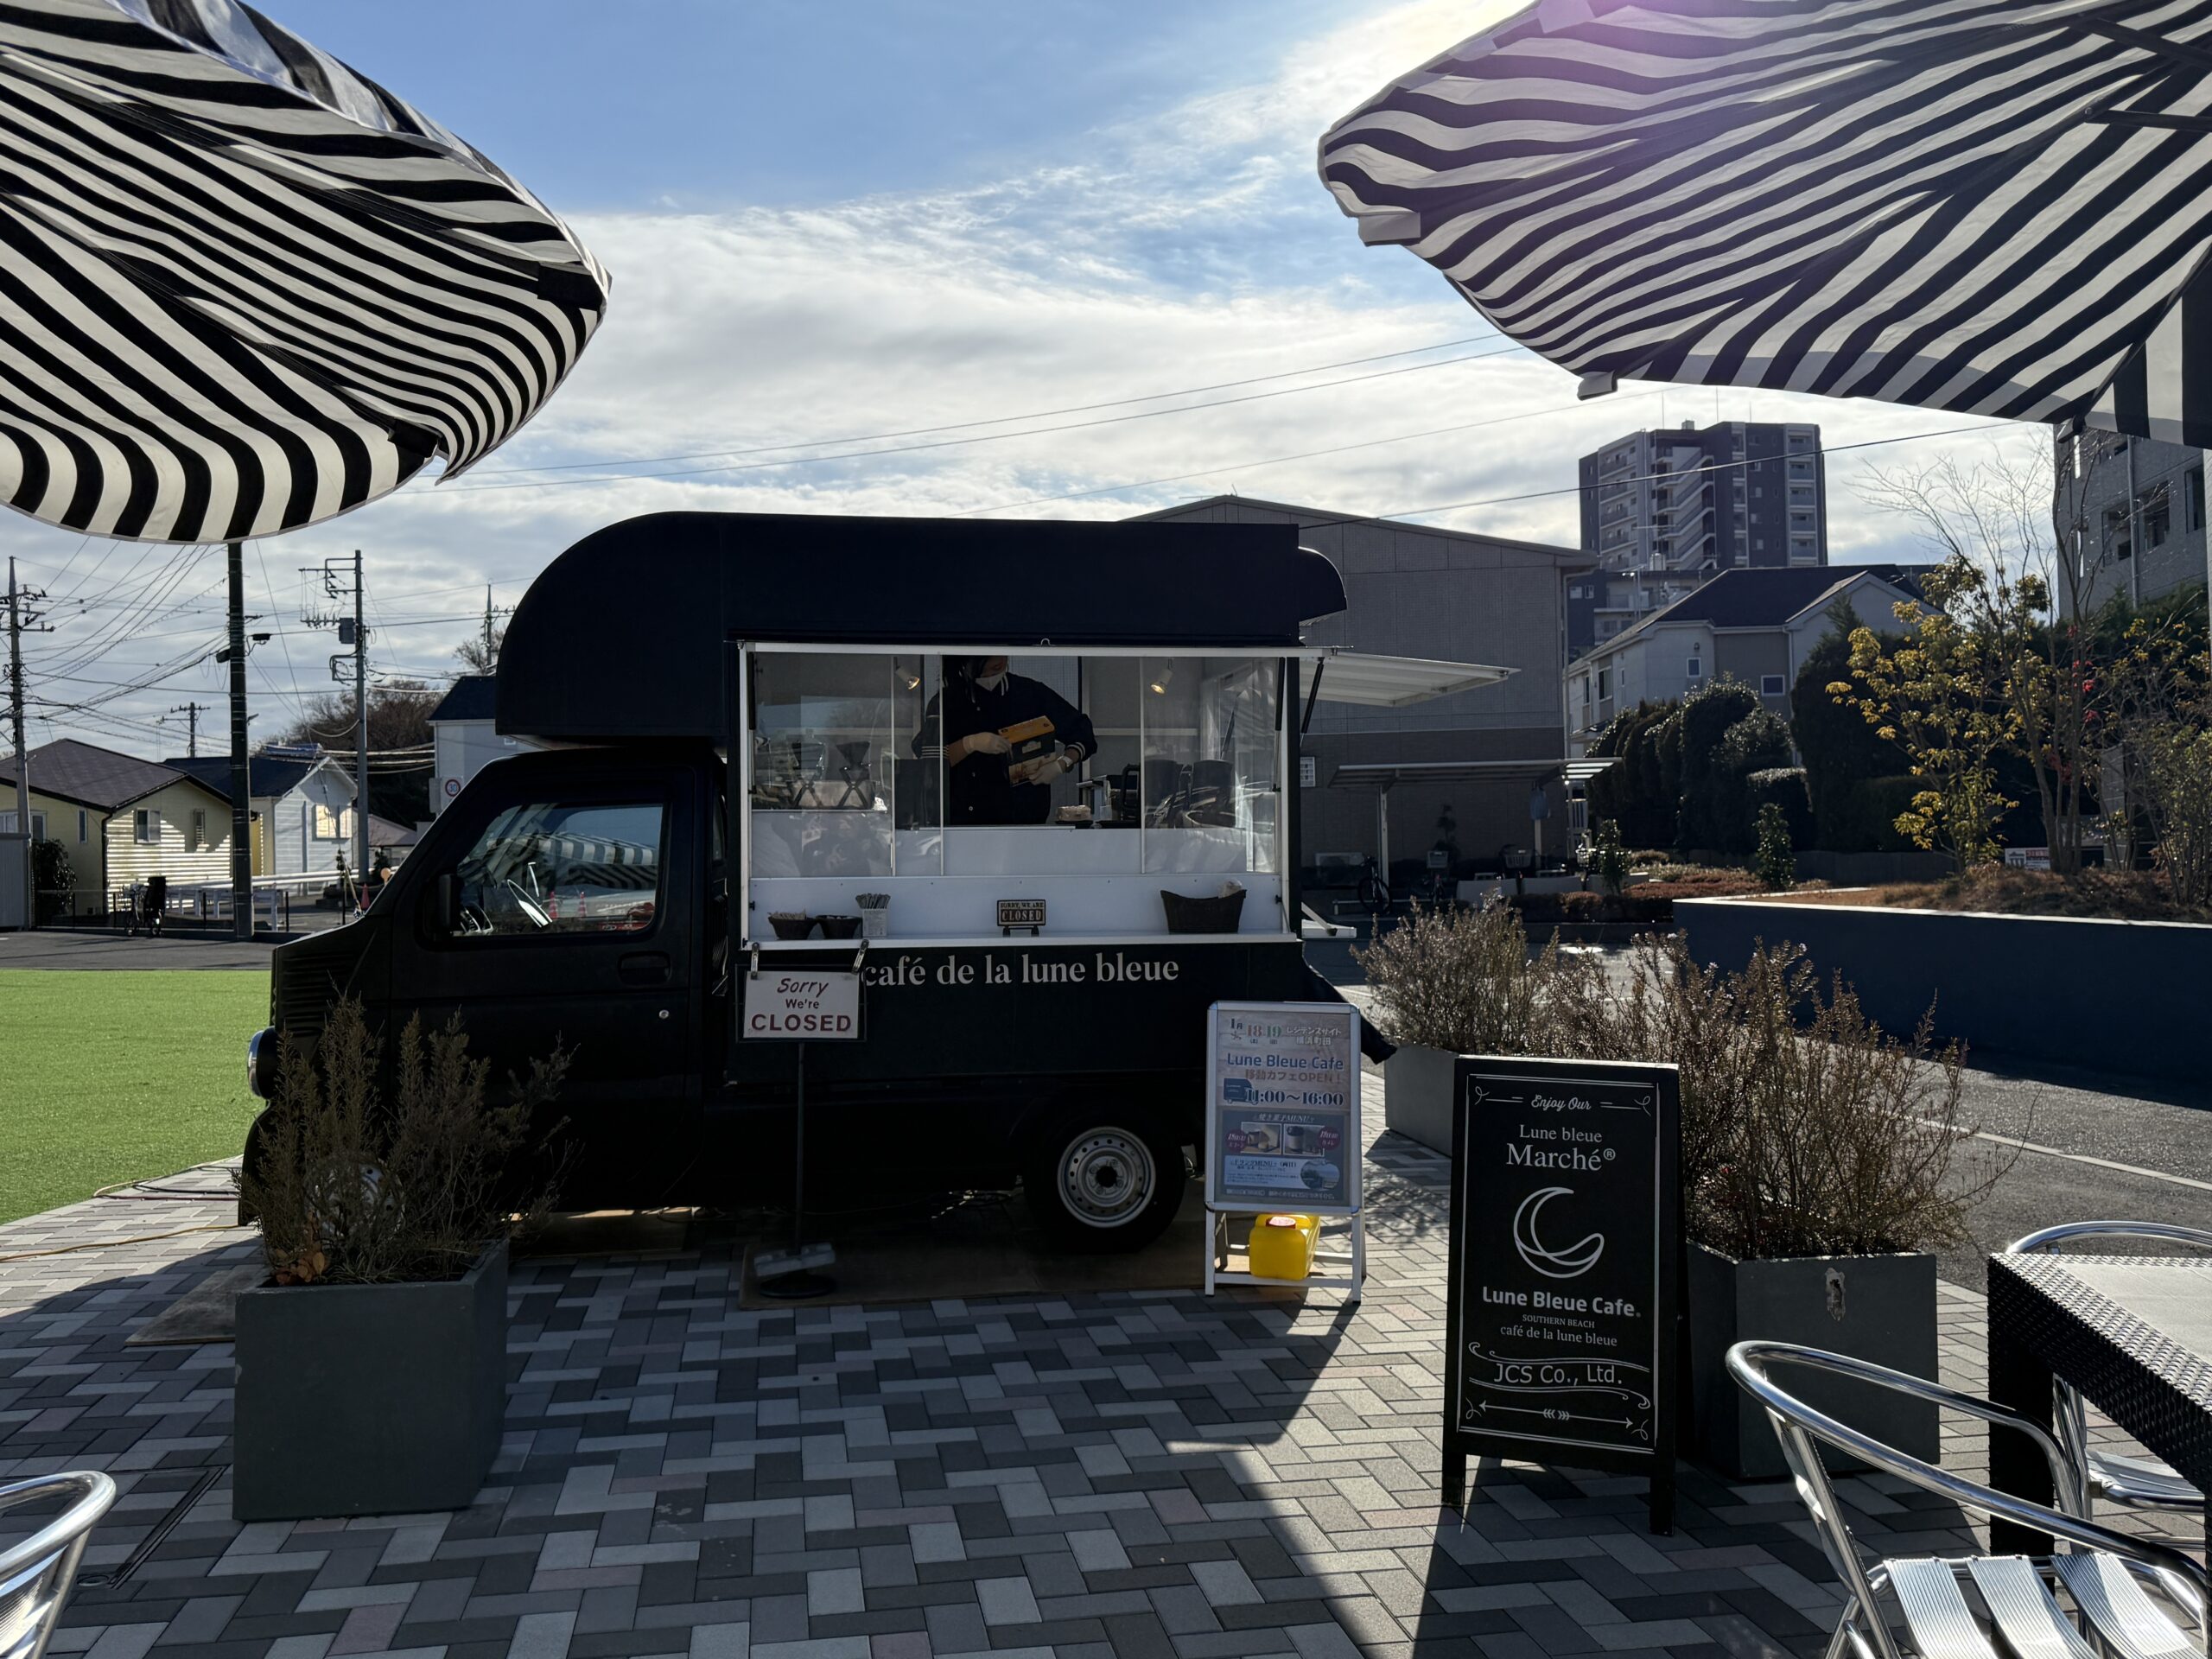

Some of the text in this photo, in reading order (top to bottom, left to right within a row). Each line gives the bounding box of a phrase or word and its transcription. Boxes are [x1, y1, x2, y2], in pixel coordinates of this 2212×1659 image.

[1002, 910, 1042, 921] CLOSED
[860, 952, 1179, 986] café de la lune bleue
[777, 977, 830, 999] Sorry
[785, 998, 820, 1010] We're
[750, 1013, 852, 1033] CLOSED
[1247, 1024, 1263, 1037] 18
[1226, 1052, 1344, 1071] Lune Bleue Cafe
[1530, 1094, 1592, 1112] Enjoy Our
[1519, 1124, 1603, 1143] Lune bleue
[1482, 1286, 1529, 1306] Lune
[1533, 1290, 1588, 1313] Bleue
[1522, 1313, 1596, 1329] SOUTHERN BEACH
[1500, 1325, 1618, 1347] café de la lune bleue
[1493, 1363, 1623, 1387] JCS Co., Ltd.
